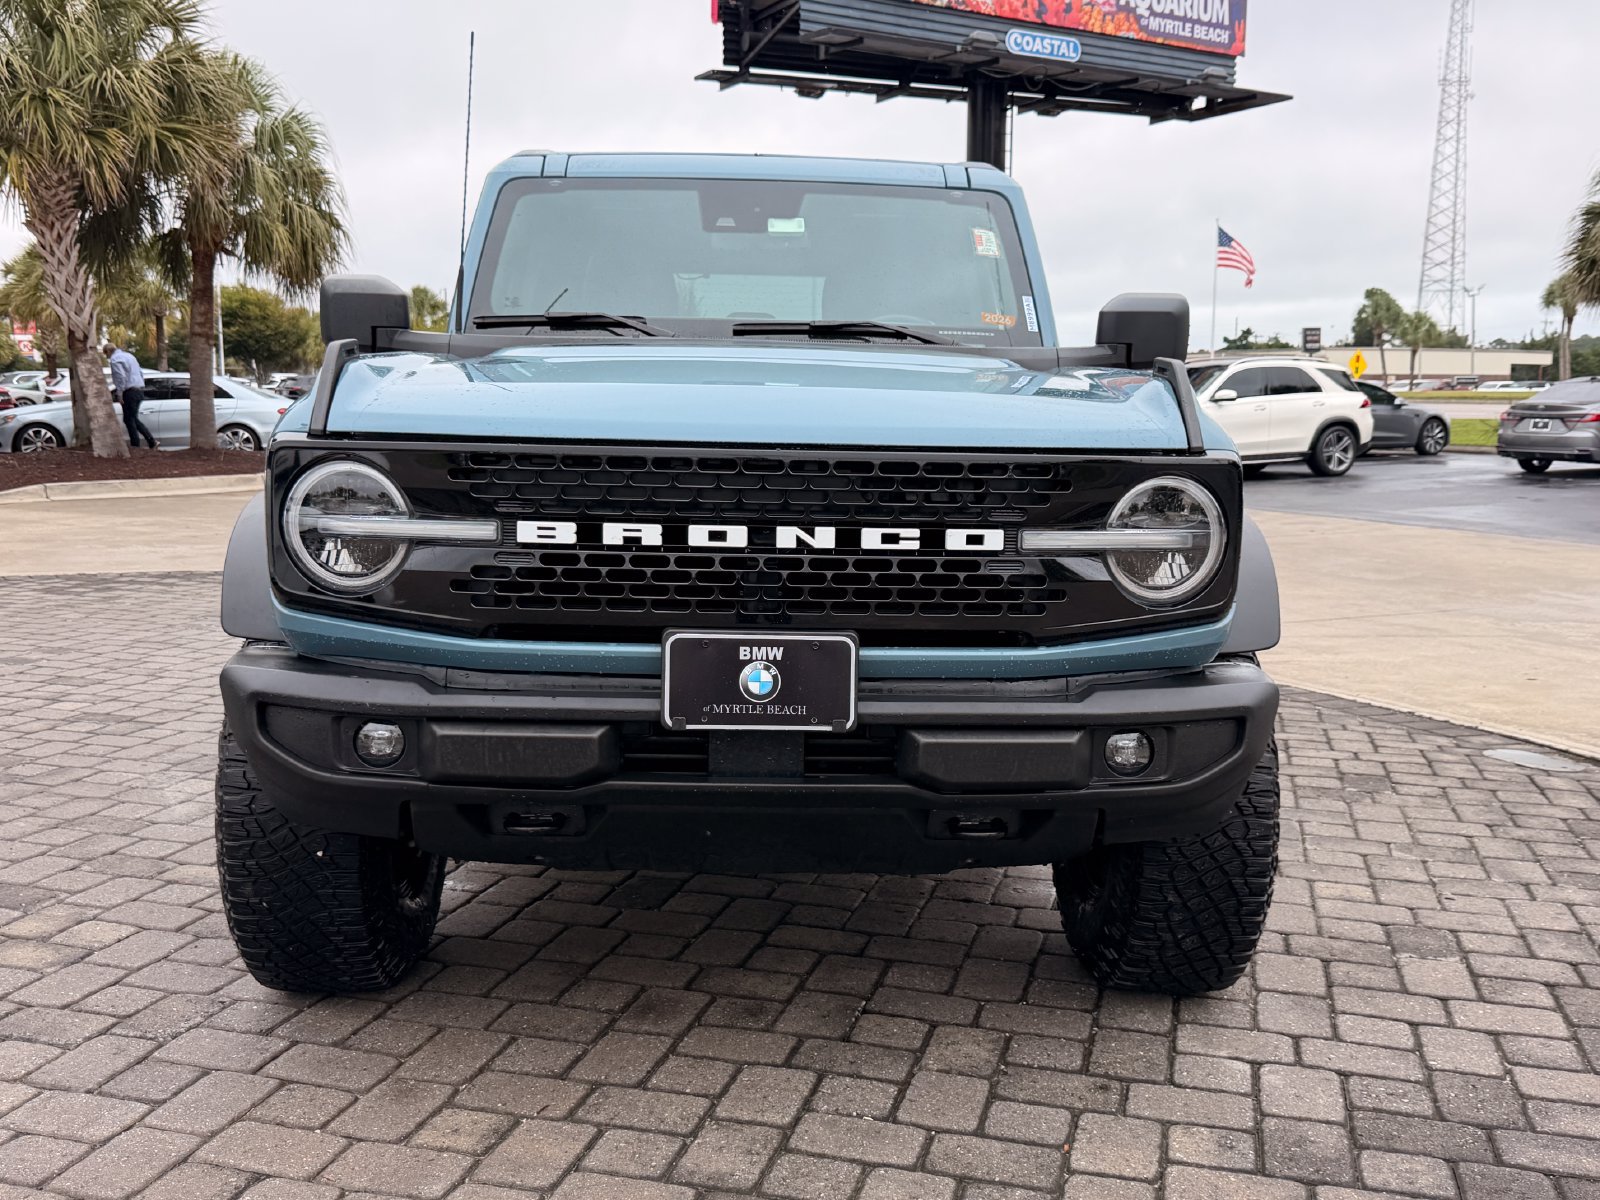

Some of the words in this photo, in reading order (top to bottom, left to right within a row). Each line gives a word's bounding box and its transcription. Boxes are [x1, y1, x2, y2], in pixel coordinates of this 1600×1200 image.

[1119, 0, 1230, 25] QUARIUM
[1148, 16, 1193, 37] MYRTLE
[1193, 24, 1229, 44] BEACH
[1009, 32, 1077, 58] COASTAL
[984, 313, 1012, 325] 2026
[516, 520, 1005, 551] BRONCO
[739, 646, 785, 661] BMW
[703, 704, 711, 712] of
[712, 703, 764, 715] MYRTLE
[766, 704, 807, 715] BEACH
